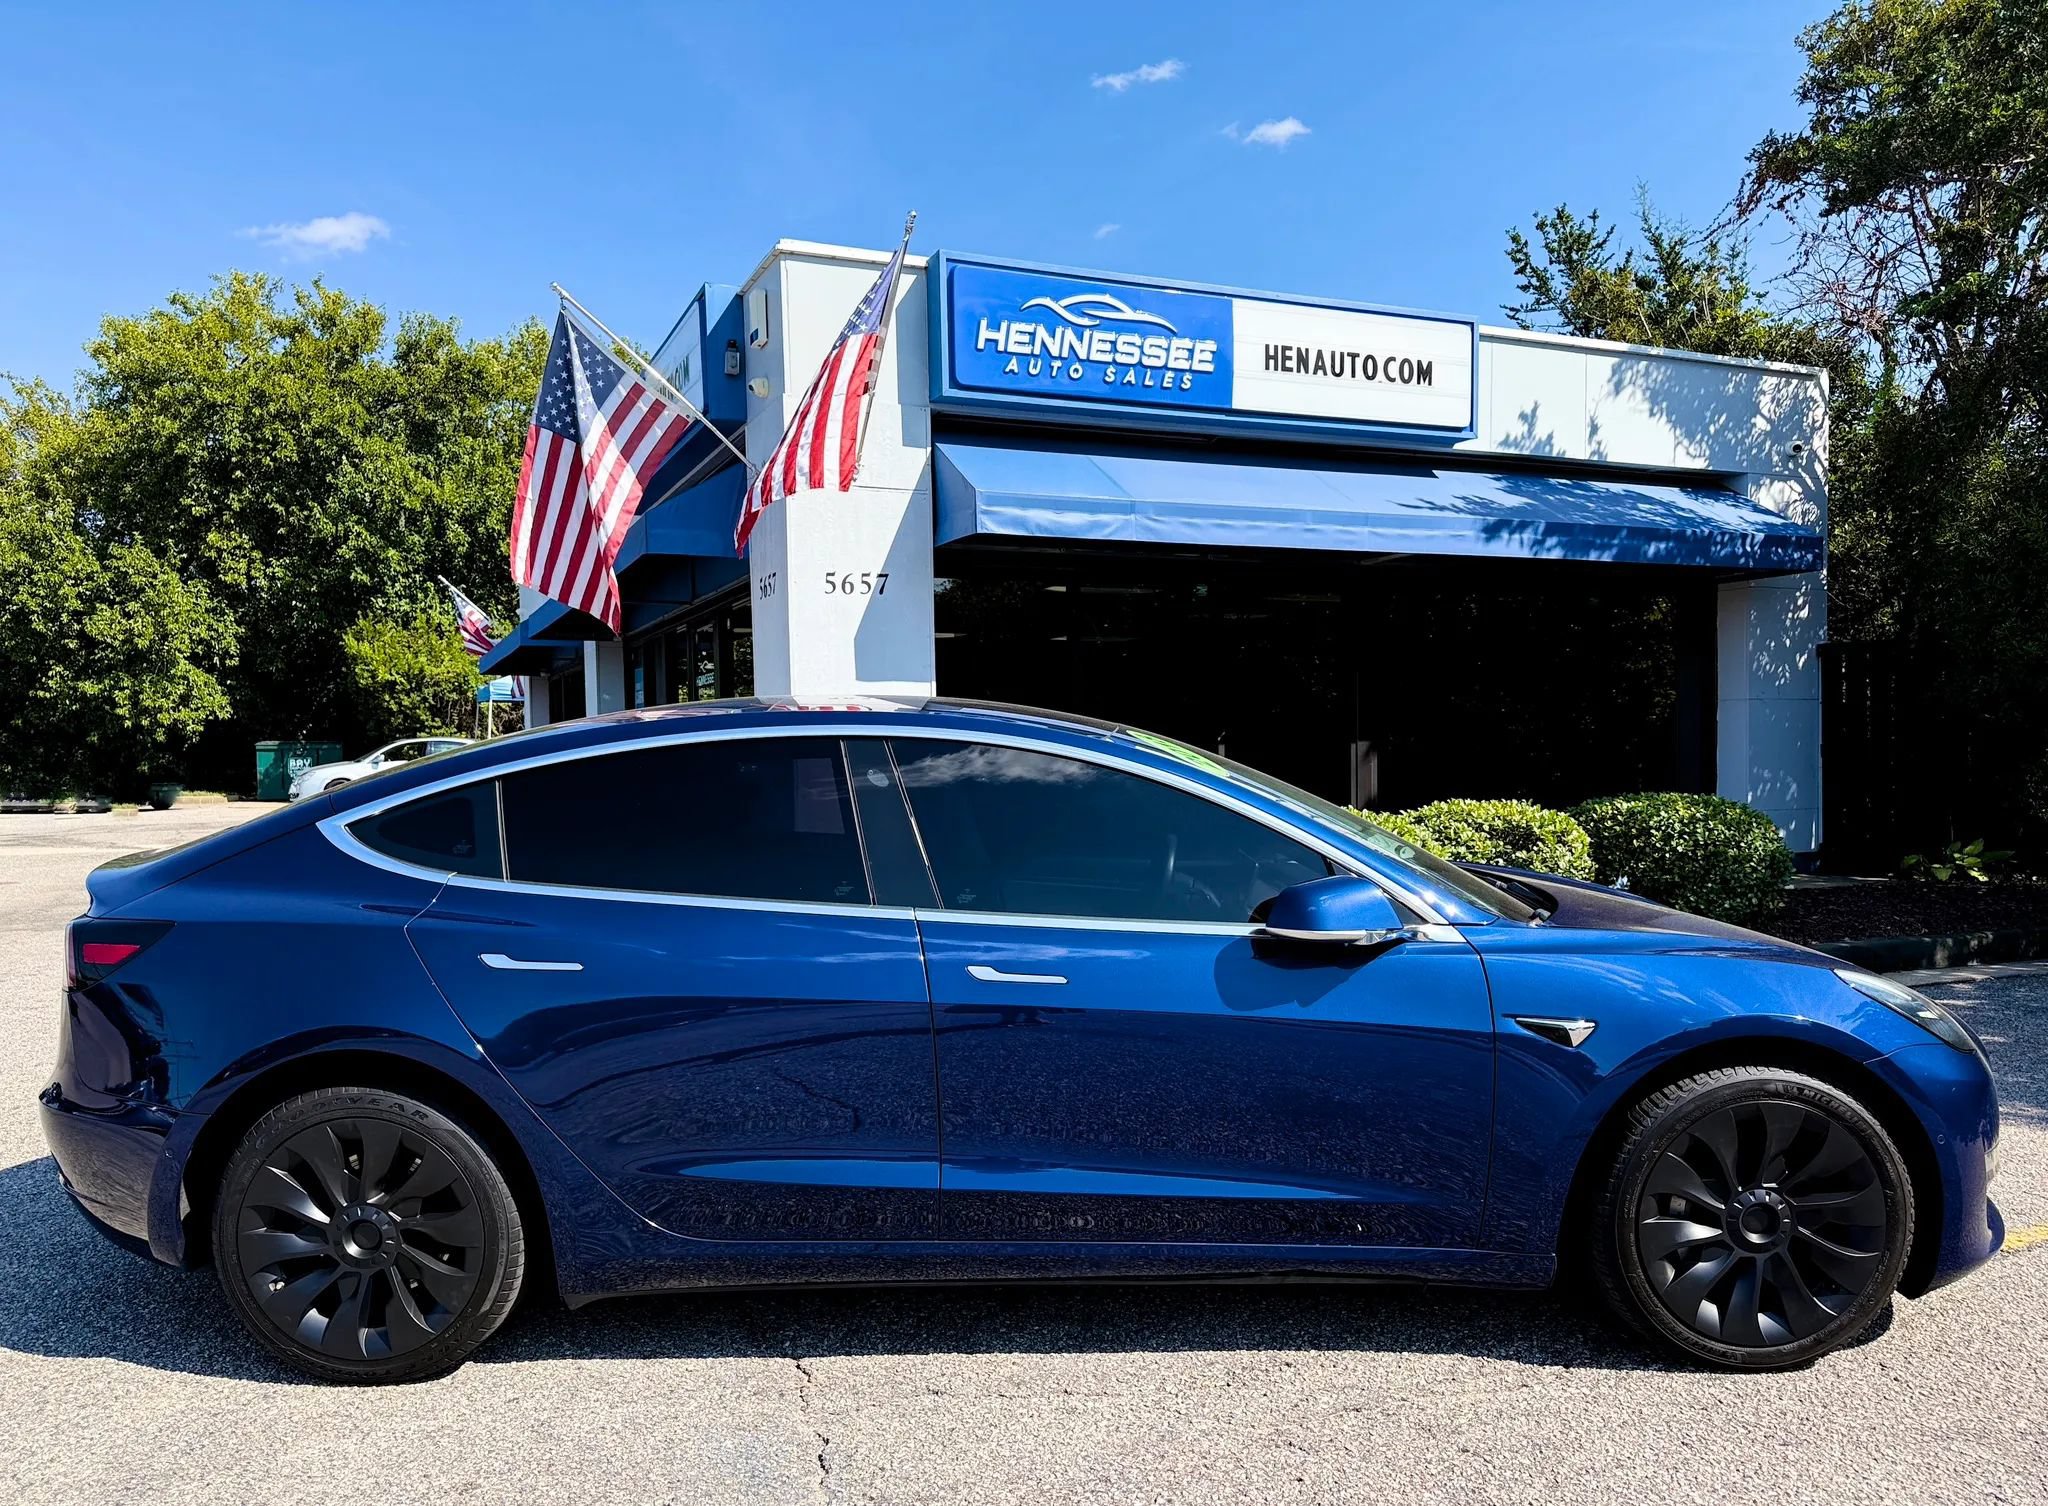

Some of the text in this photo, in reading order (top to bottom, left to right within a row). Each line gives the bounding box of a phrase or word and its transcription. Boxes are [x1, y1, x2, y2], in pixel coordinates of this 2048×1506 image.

[977, 317, 1218, 372] HENNESSEE
[1005, 356, 1193, 390] AUTO SALES
[759, 571, 777, 600] 5657
[824, 571, 890, 596] 5657
